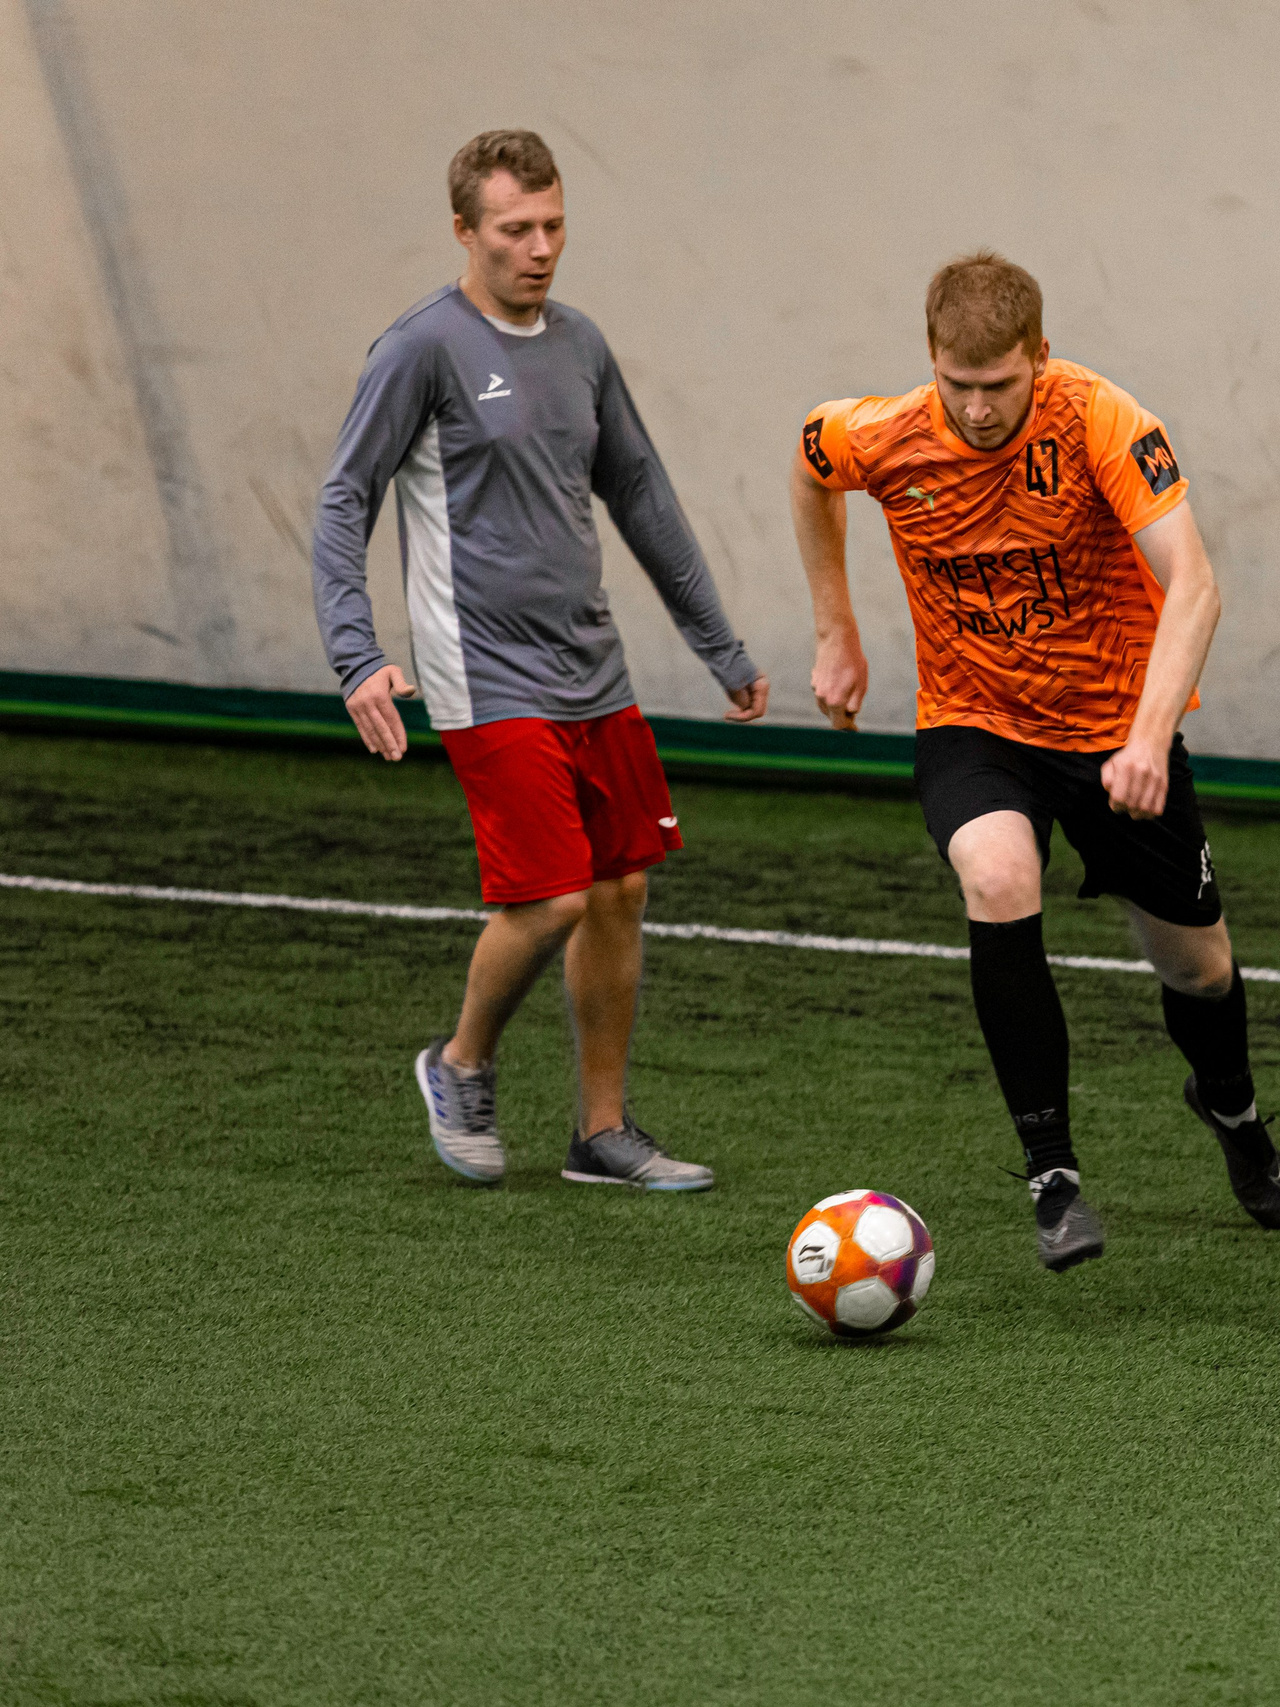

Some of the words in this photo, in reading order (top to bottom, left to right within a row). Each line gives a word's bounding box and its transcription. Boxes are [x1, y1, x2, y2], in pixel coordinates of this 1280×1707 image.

[1026, 438, 1058, 497] 47
[923, 543, 1070, 618] MERCH
[954, 598, 1054, 639] NEWS
